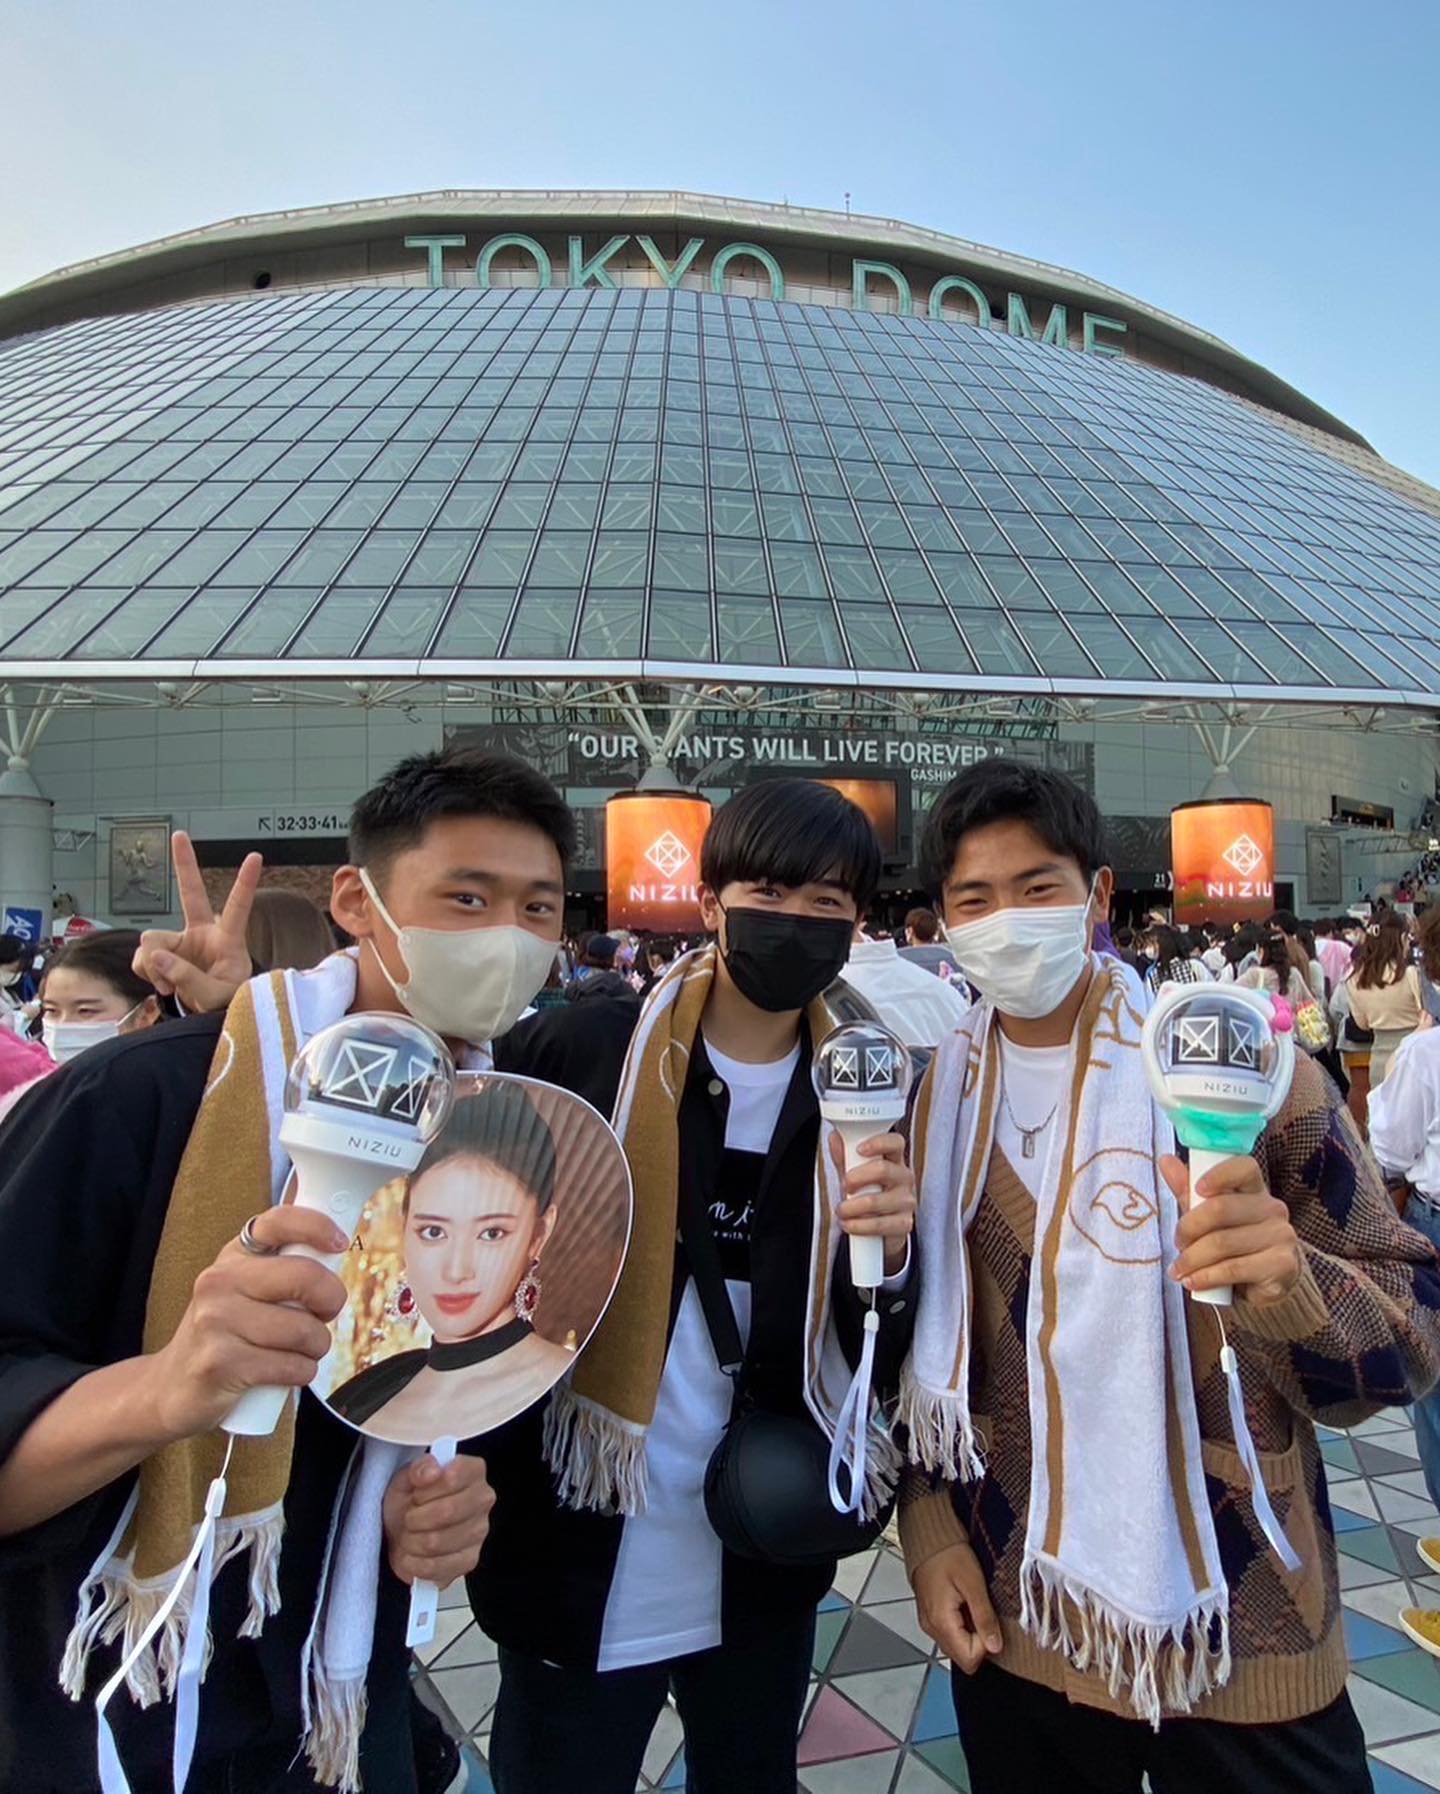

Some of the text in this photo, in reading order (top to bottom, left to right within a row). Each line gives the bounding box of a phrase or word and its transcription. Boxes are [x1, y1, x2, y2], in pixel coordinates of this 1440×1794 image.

[404, 232, 1128, 358] TOKYO DOME
[753, 737, 816, 760] WILL
[824, 740, 878, 762] LIVE
[1206, 882, 1272, 897] NIZIU
[1203, 1081, 1248, 1096] NIZIU
[348, 1136, 402, 1157] NIZIU
